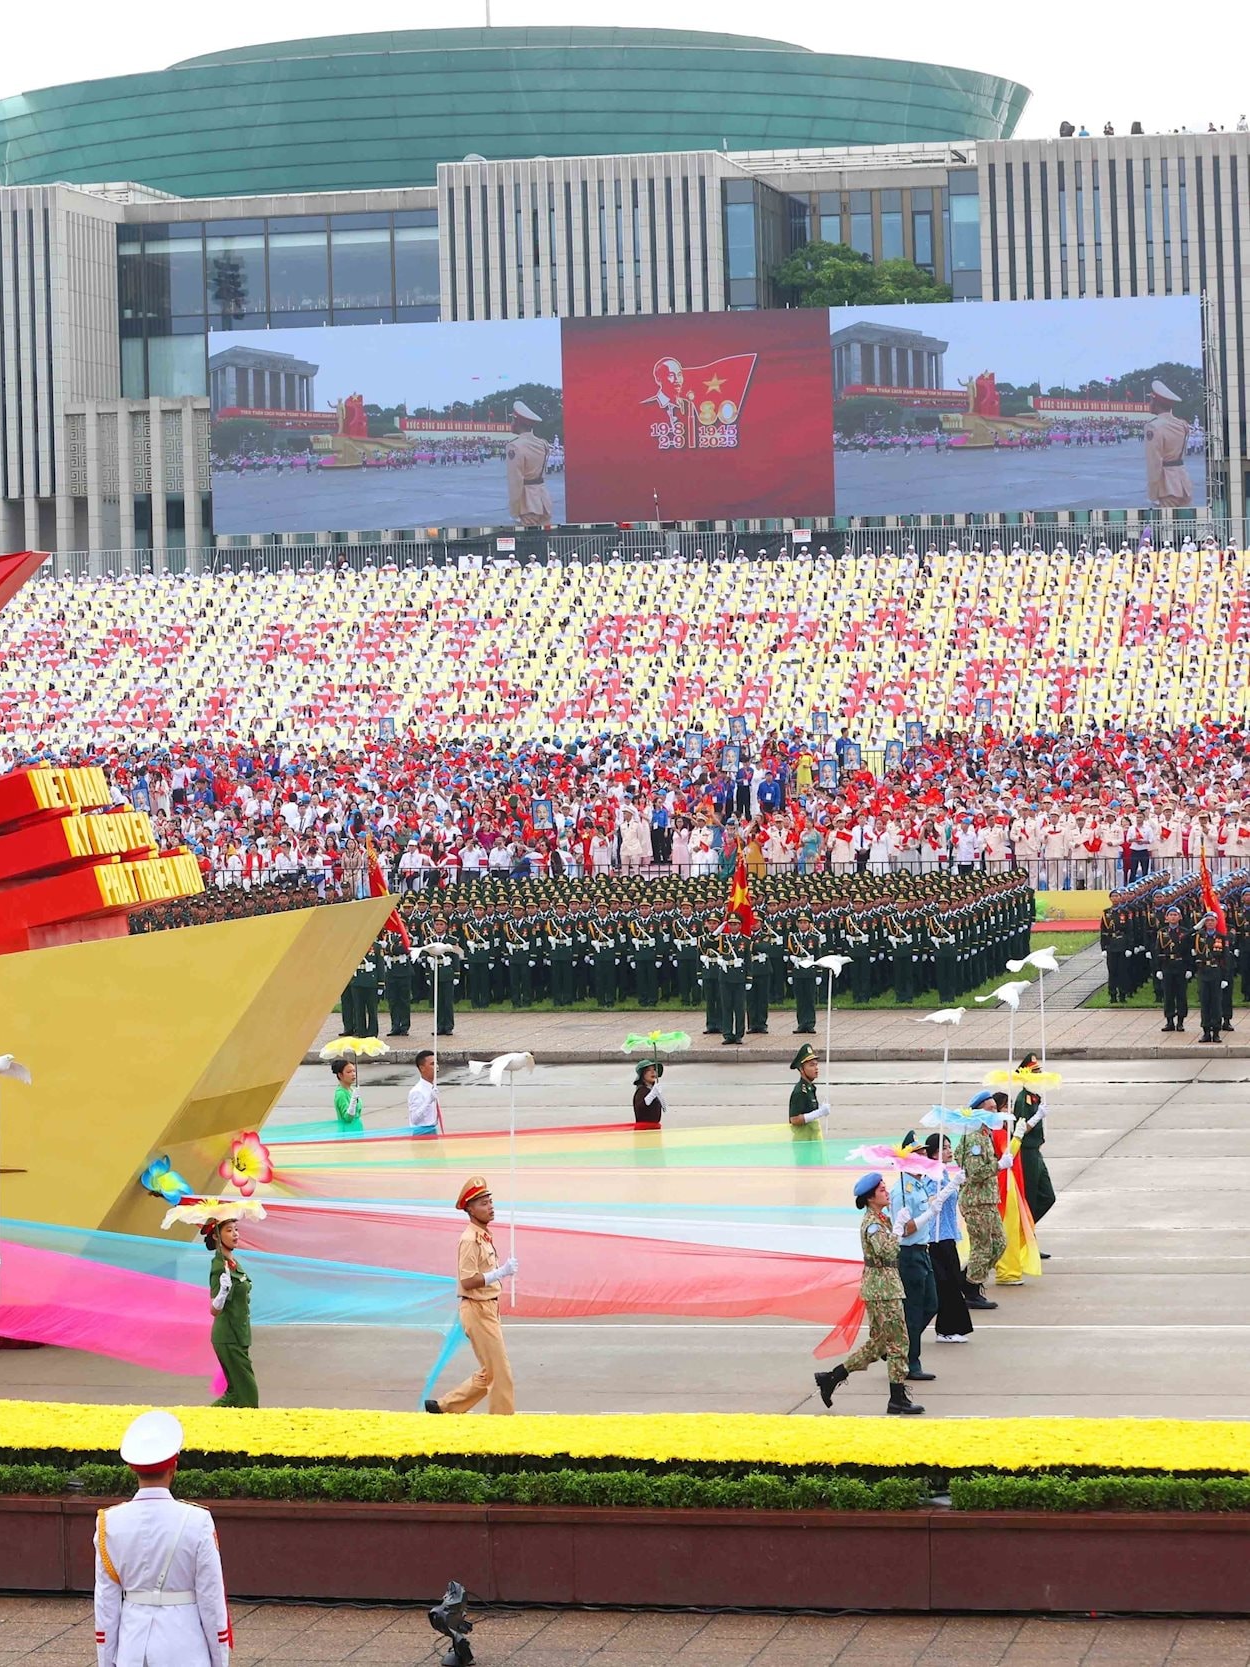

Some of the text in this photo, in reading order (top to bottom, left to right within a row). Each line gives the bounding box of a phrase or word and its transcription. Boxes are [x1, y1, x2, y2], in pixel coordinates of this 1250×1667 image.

[700, 400, 738, 425] 80
[698, 424, 738, 436] 1945
[698, 436, 738, 448] 2025
[67, 766, 113, 807] NAM
